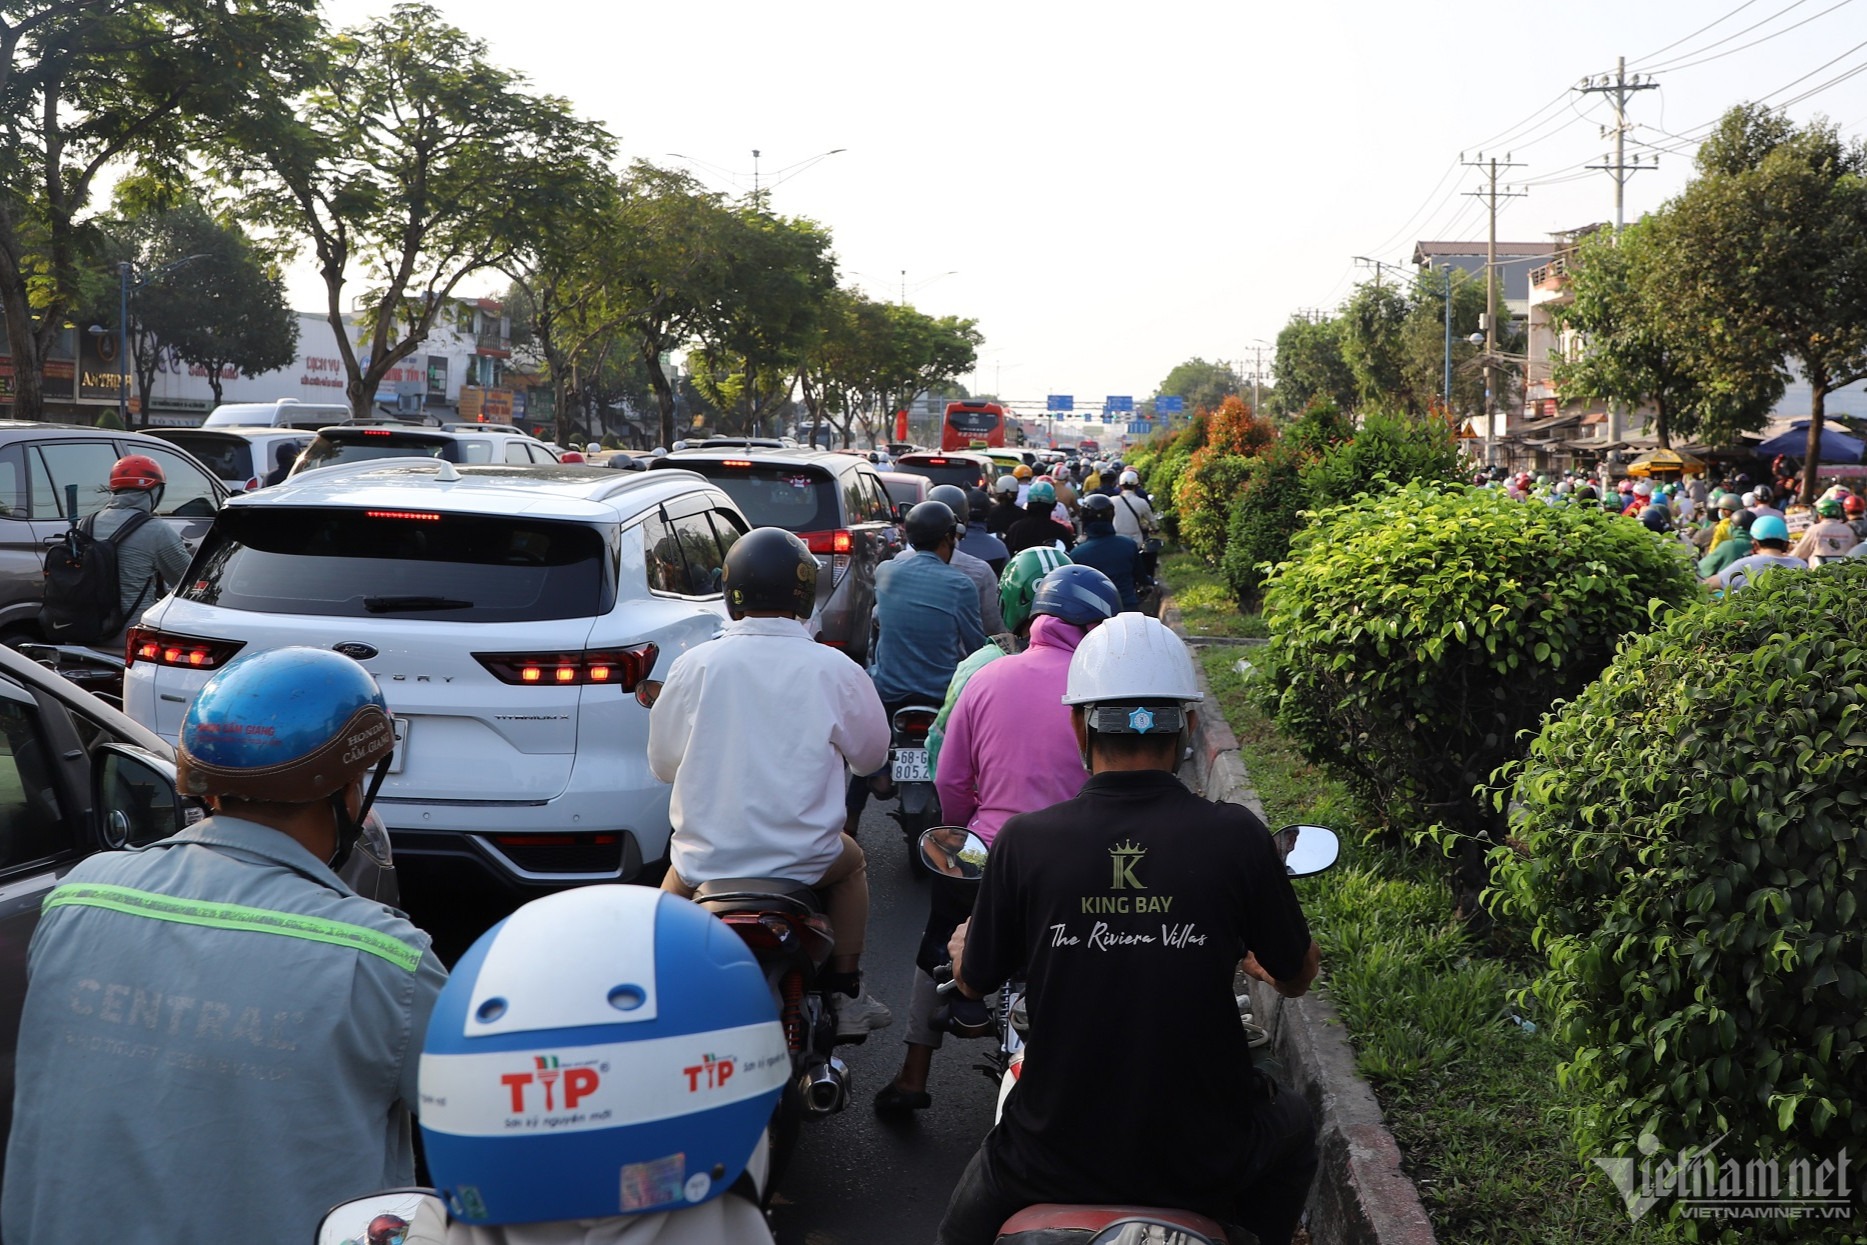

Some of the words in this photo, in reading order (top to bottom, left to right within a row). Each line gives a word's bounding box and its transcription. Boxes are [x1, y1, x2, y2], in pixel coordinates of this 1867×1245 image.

[347, 722, 386, 747] HONDA
[901, 751, 928, 764] 68-G
[895, 765, 929, 779] 805.2
[1110, 854, 1148, 889] K
[1081, 896, 1129, 914] KING
[1136, 896, 1173, 913] BAY
[1050, 923, 1080, 948] The
[1087, 921, 1157, 951] Riviera
[1161, 922, 1208, 948] Villas
